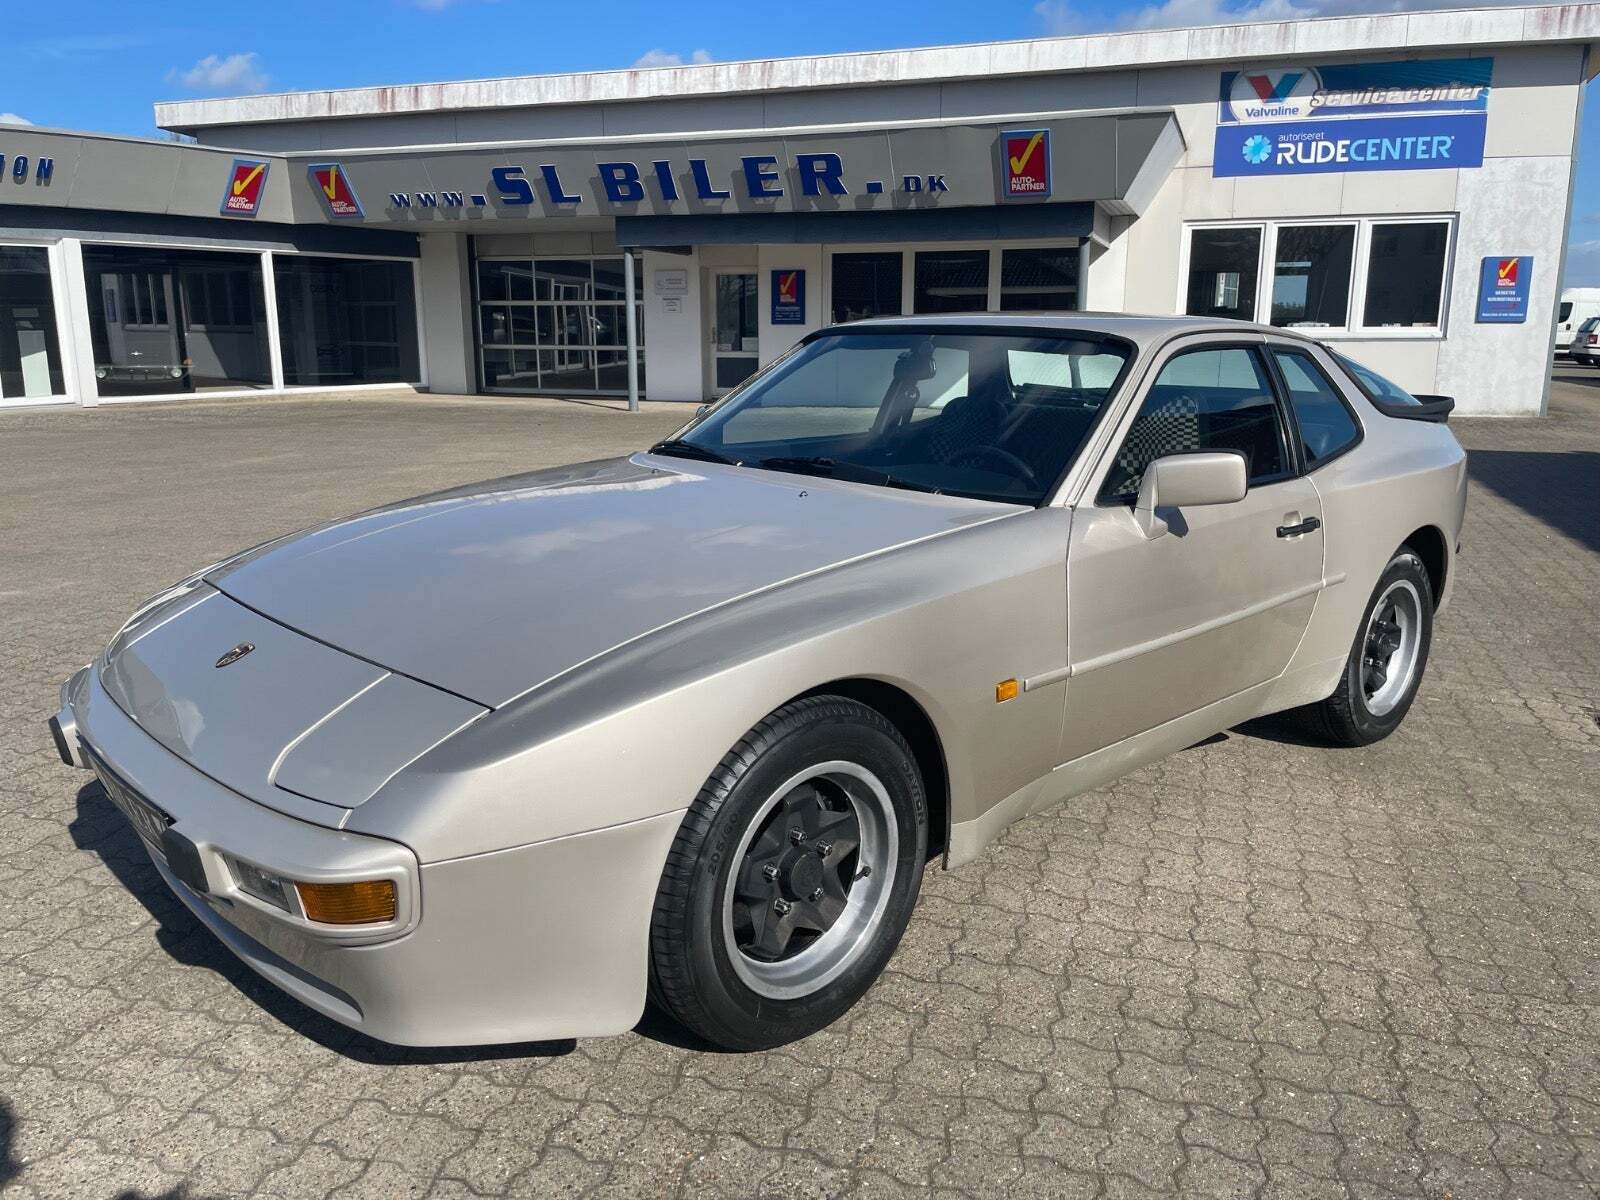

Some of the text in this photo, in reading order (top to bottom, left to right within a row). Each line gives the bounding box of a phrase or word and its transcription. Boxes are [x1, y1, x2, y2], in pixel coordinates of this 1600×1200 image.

[1246, 105, 1300, 118] Valvoline
[1278, 131, 1325, 142] autoriseret
[1011, 176, 1036, 184] AUTO-
[1011, 182, 1046, 191] PARTNER
